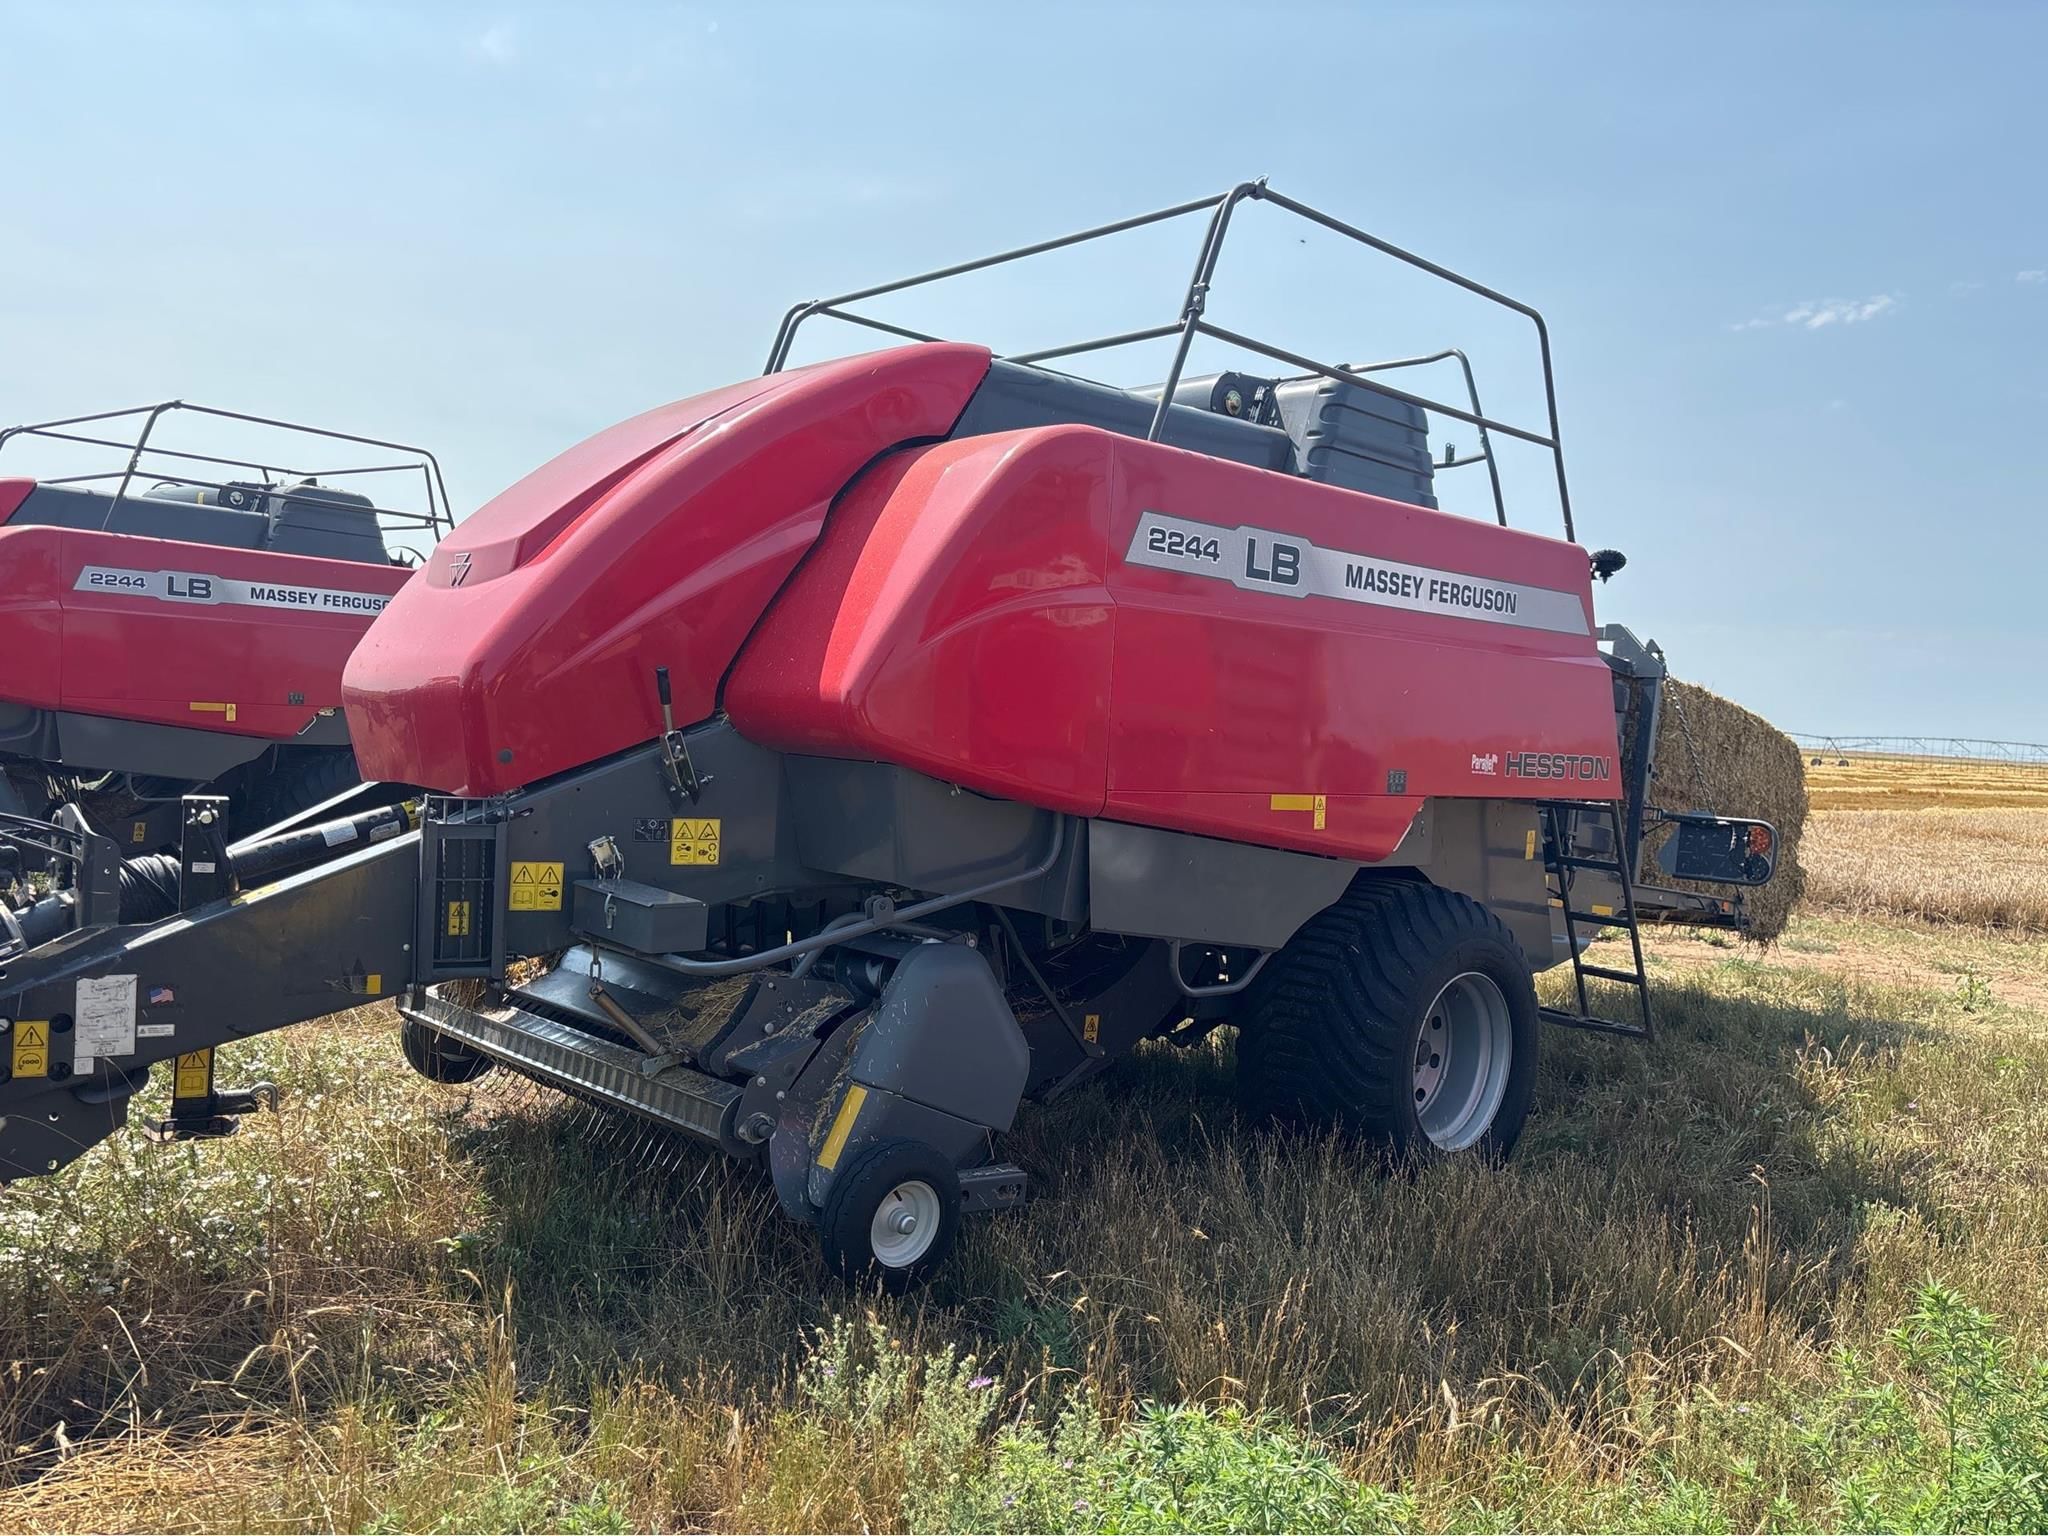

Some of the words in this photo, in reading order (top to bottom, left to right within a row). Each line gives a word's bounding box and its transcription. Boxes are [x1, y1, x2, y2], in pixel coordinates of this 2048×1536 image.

[1147, 526, 1220, 563] 2244
[1245, 537, 1300, 586] LB
[1345, 564, 1424, 599] MASSEY
[1429, 579, 1517, 614] FERGUSON
[90, 573, 146, 588] 2244
[167, 576, 212, 598] LB
[250, 587, 318, 604] MASSEY
[323, 594, 390, 611] FERGUS
[1505, 752, 1610, 780] HESSTON
